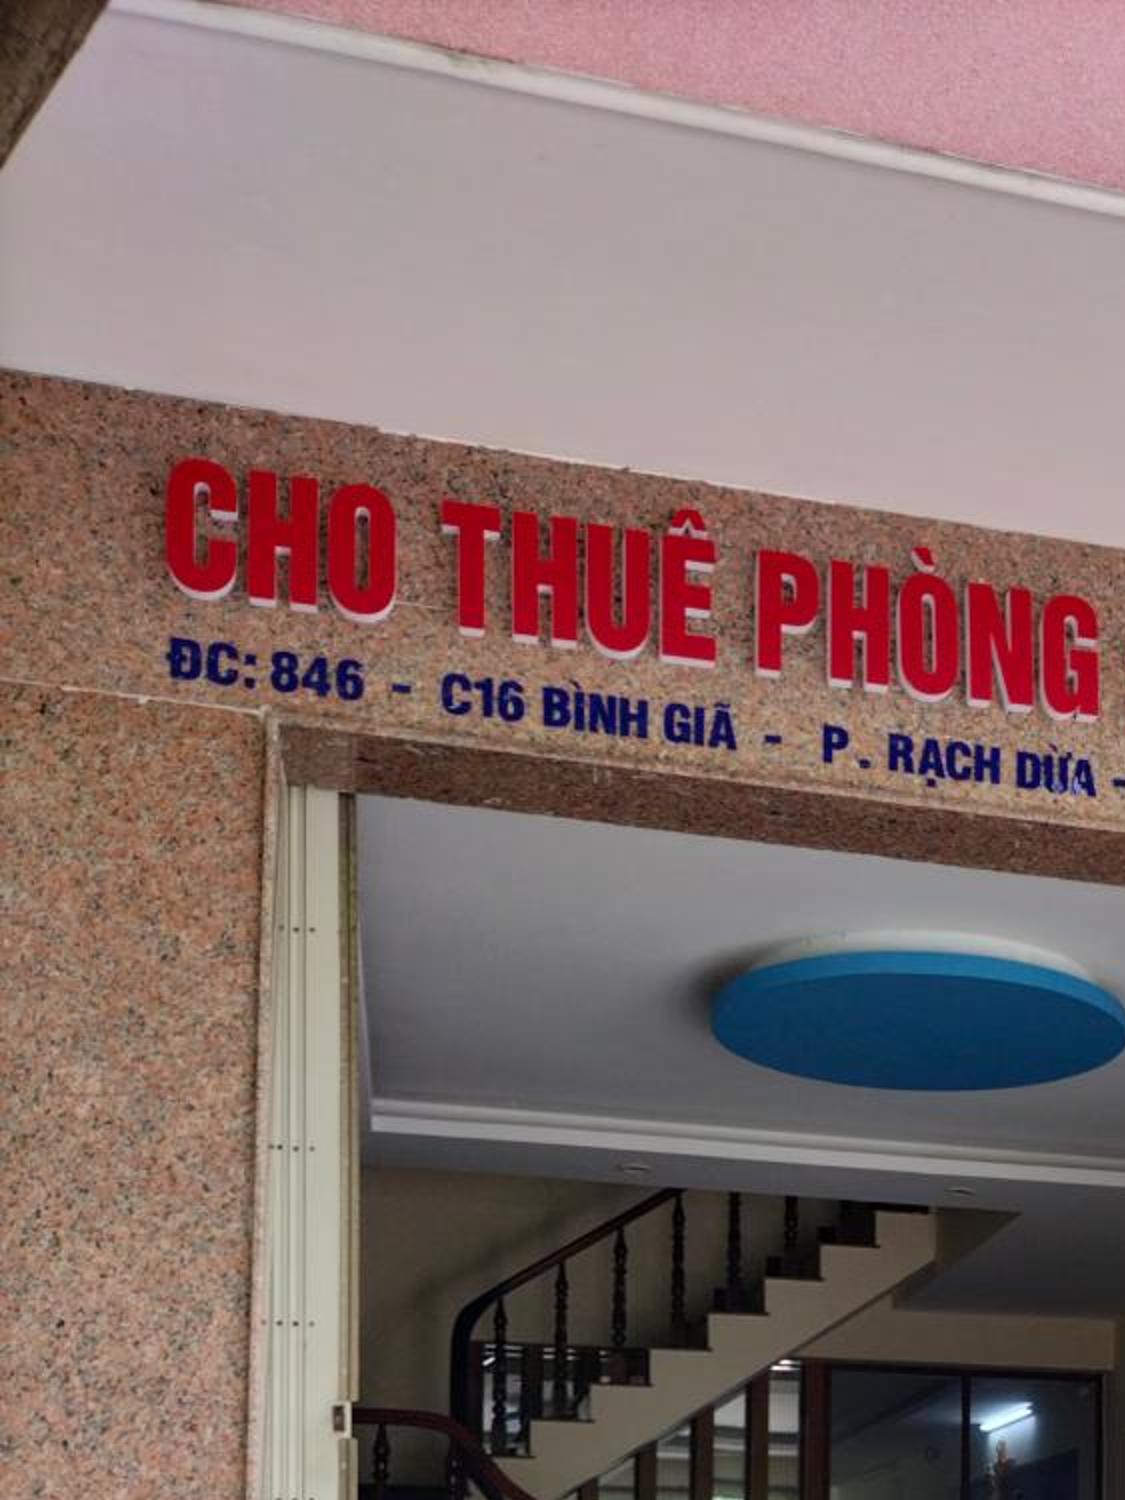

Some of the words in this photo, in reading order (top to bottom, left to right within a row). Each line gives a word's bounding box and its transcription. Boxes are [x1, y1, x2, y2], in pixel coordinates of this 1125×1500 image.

[164, 456, 397, 624] CHO
[440, 501, 719, 668] THUÊ
[756, 546, 1100, 722] PHÒNG
[440, 672, 525, 722] C16
[542, 678, 649, 739] BÌNH
[663, 702, 737, 751] GIÃ
[887, 732, 1001, 788] RẠCH
[1015, 743, 1097, 797] DỪA
